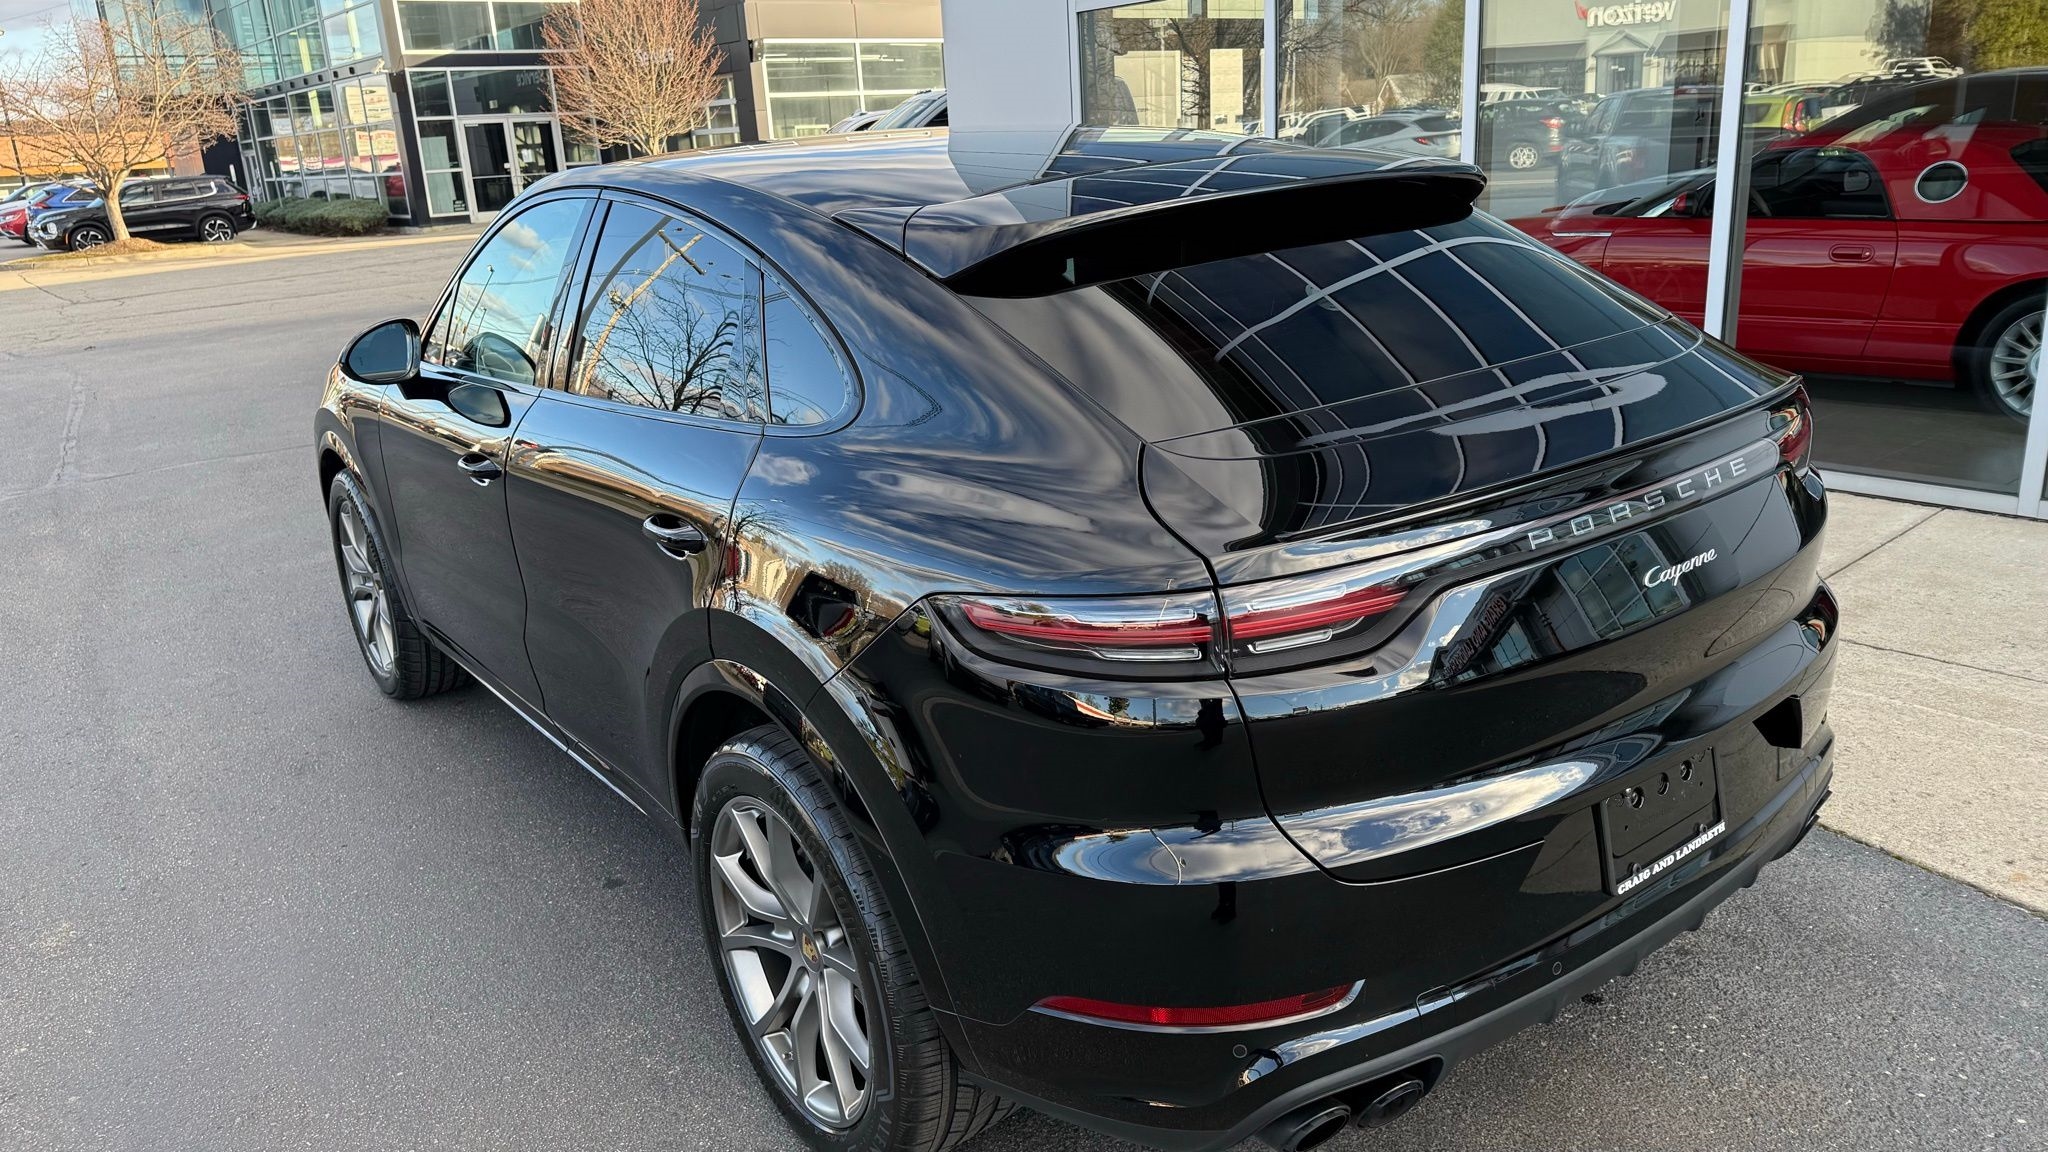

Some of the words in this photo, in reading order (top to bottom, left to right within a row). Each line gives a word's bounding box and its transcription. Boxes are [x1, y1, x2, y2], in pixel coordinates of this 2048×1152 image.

[1527, 457, 1748, 550] PORSCHE
[1643, 547, 1718, 589] Cayenne
[1617, 868, 1651, 895] CRAIG
[1652, 853, 1675, 876] AND
[1676, 821, 1726, 860] LANDRETH
